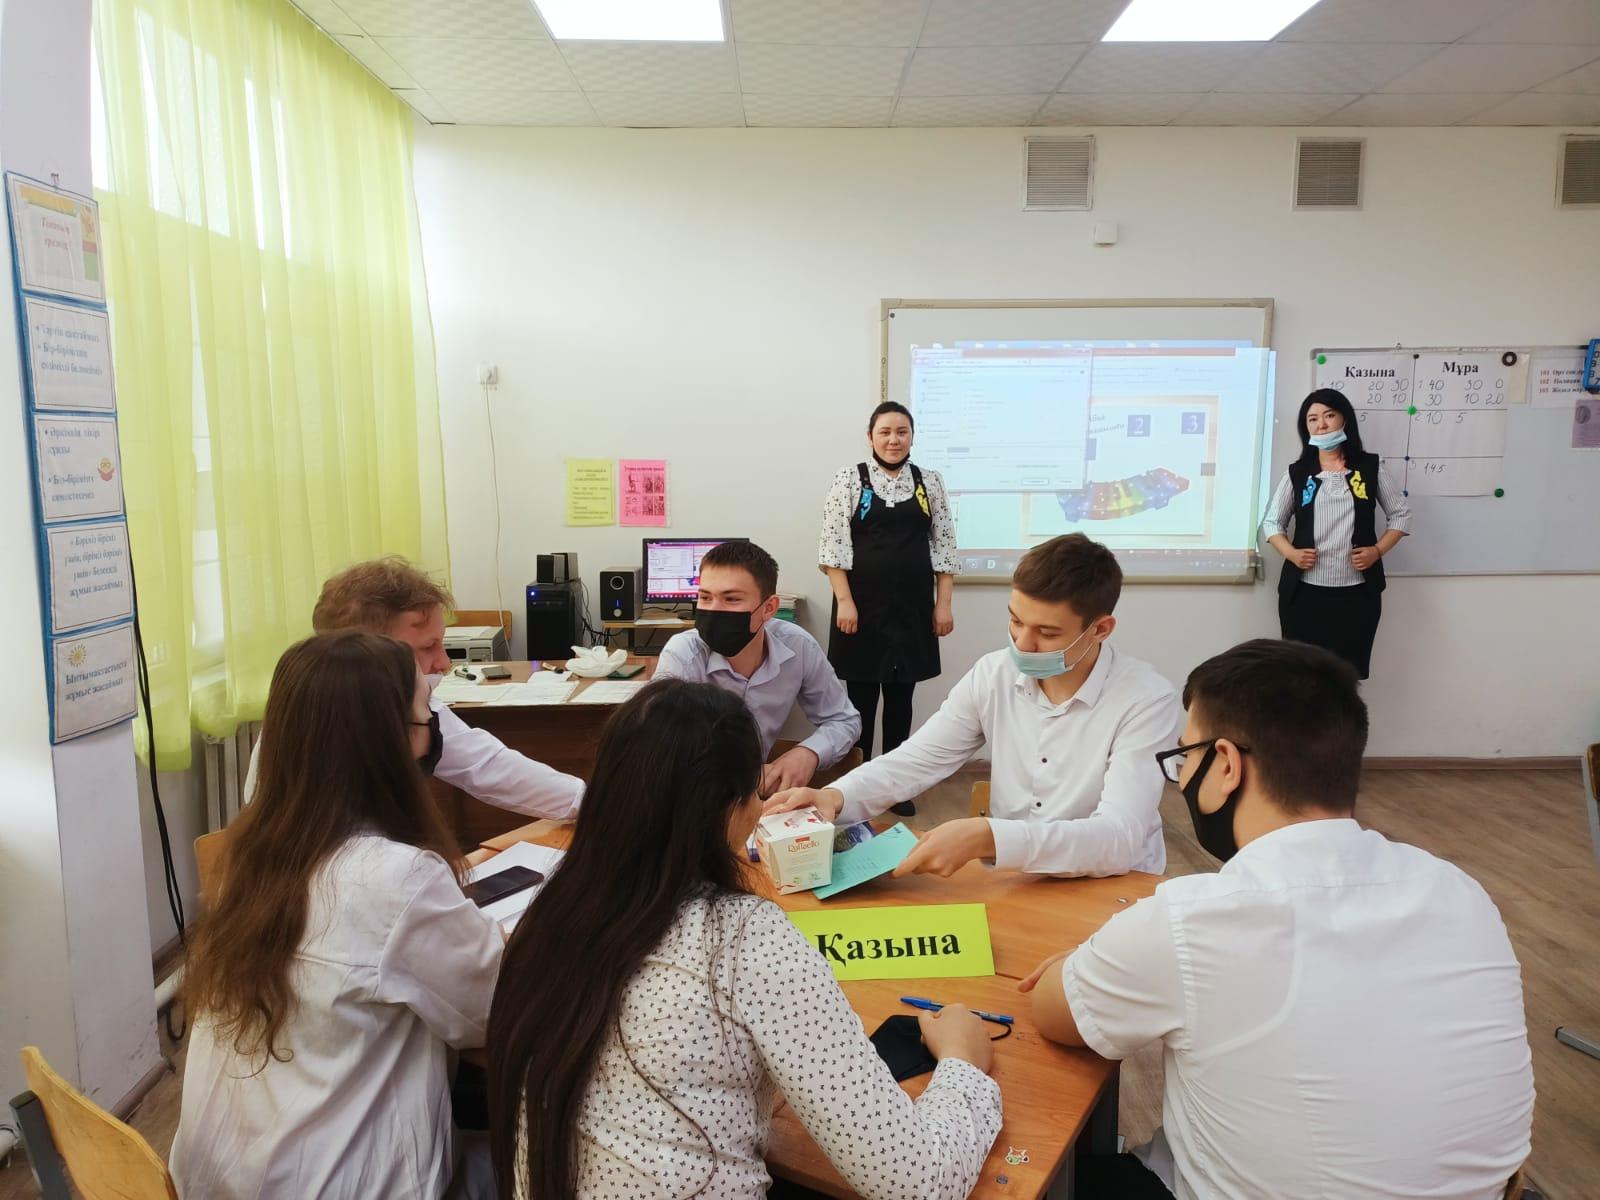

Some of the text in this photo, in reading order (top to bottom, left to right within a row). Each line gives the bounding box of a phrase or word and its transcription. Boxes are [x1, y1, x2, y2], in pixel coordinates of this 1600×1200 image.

[1345, 366, 1396, 379] Қазына
[1442, 361, 1479, 376] Мұра
[1429, 379, 1445, 391] 40
[1392, 392, 1407, 406] 10
[1464, 392, 1480, 404] 10
[814, 931, 962, 967] Қазына
